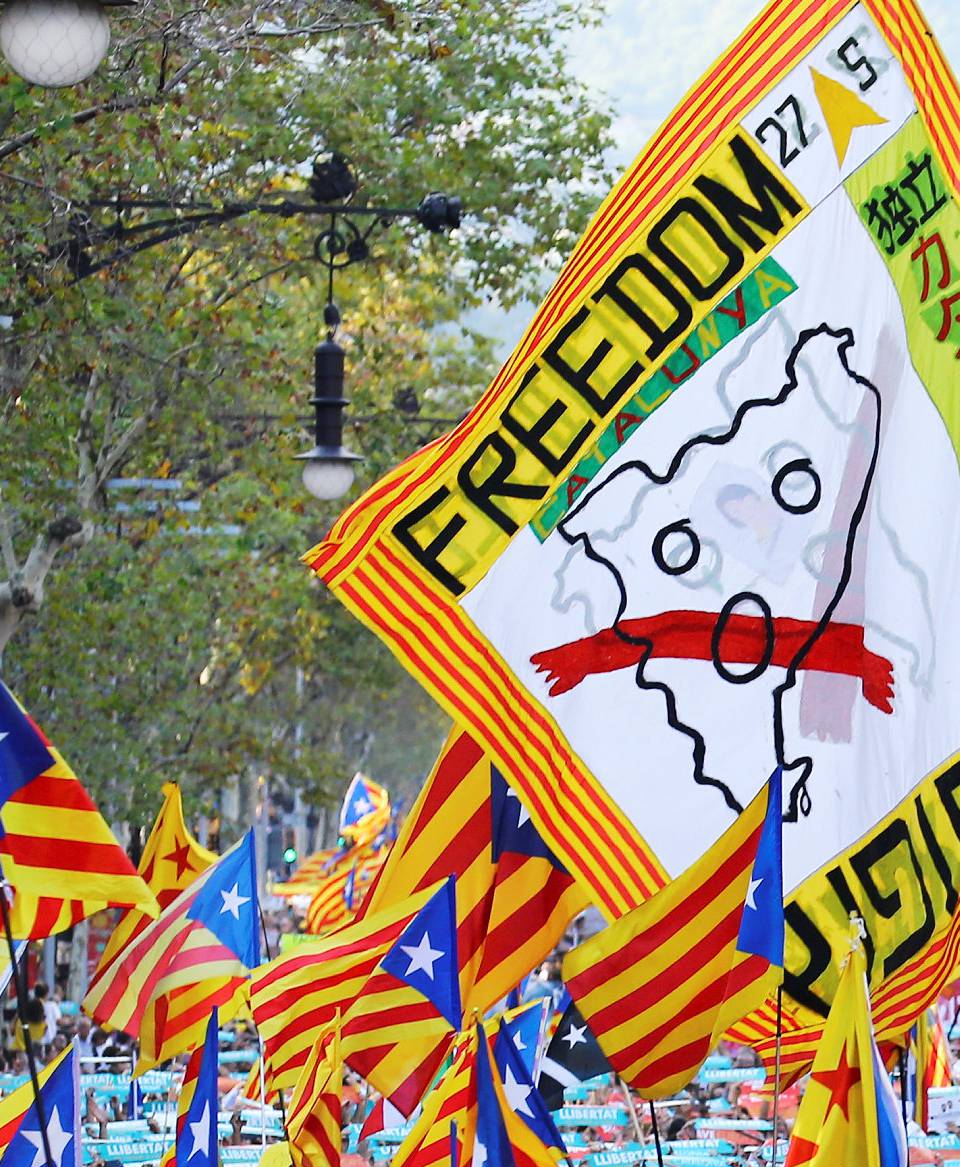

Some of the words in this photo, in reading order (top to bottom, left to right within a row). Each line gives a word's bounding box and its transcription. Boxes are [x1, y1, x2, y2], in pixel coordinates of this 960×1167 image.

[755, 94, 808, 169] 27
[391, 133, 804, 596] FREEDOM
[532, 269, 793, 538] CATALUNYA
[559, 1108, 618, 1119] LLIBERTAT
